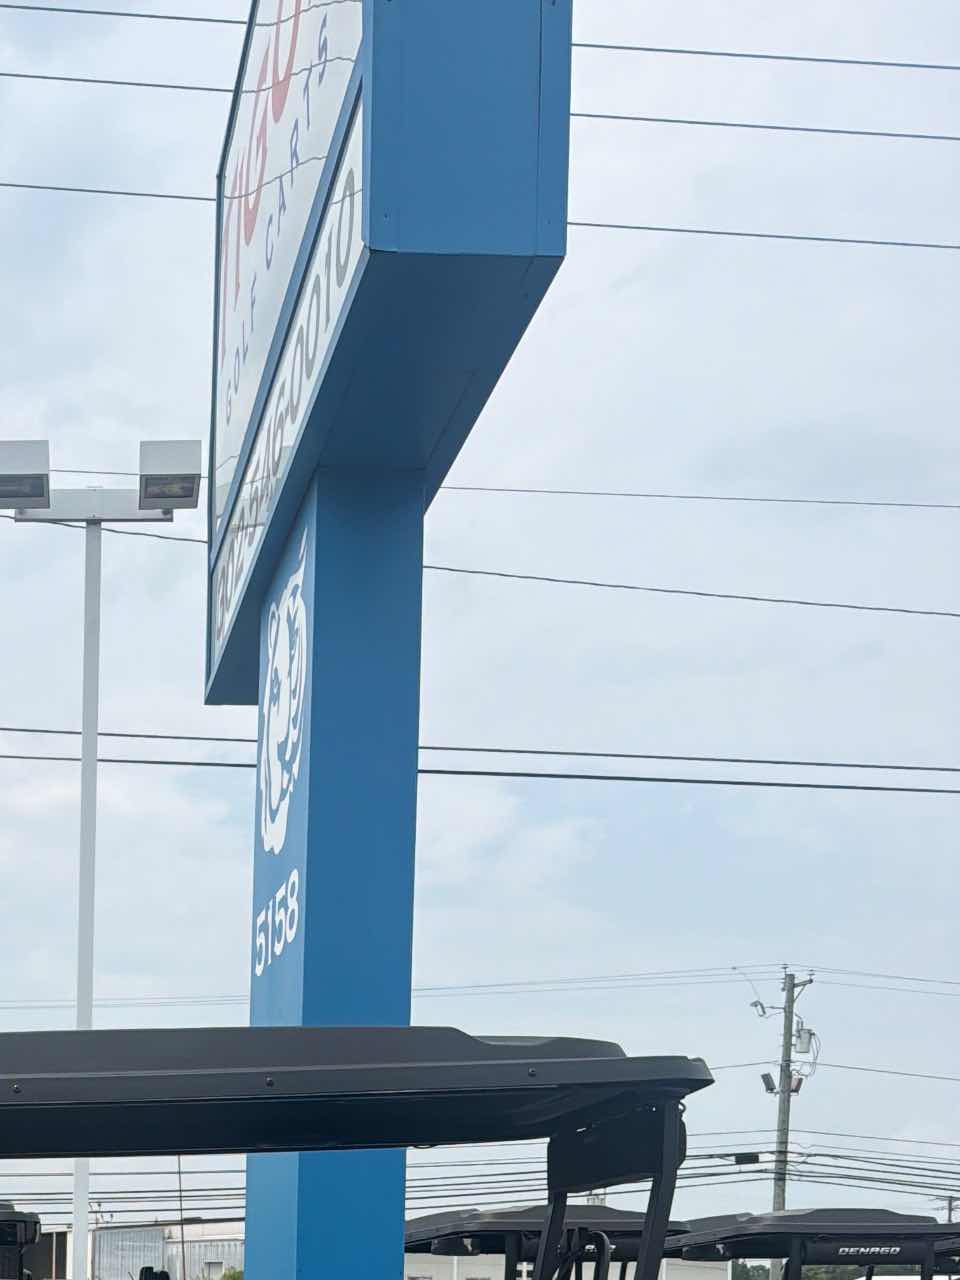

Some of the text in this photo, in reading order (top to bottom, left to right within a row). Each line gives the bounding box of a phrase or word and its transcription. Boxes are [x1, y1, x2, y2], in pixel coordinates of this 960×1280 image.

[225, 12, 329, 427] GOLF CARTS
[255, 868, 300, 977] 5158
[838, 1246, 901, 1256] DENAGO
